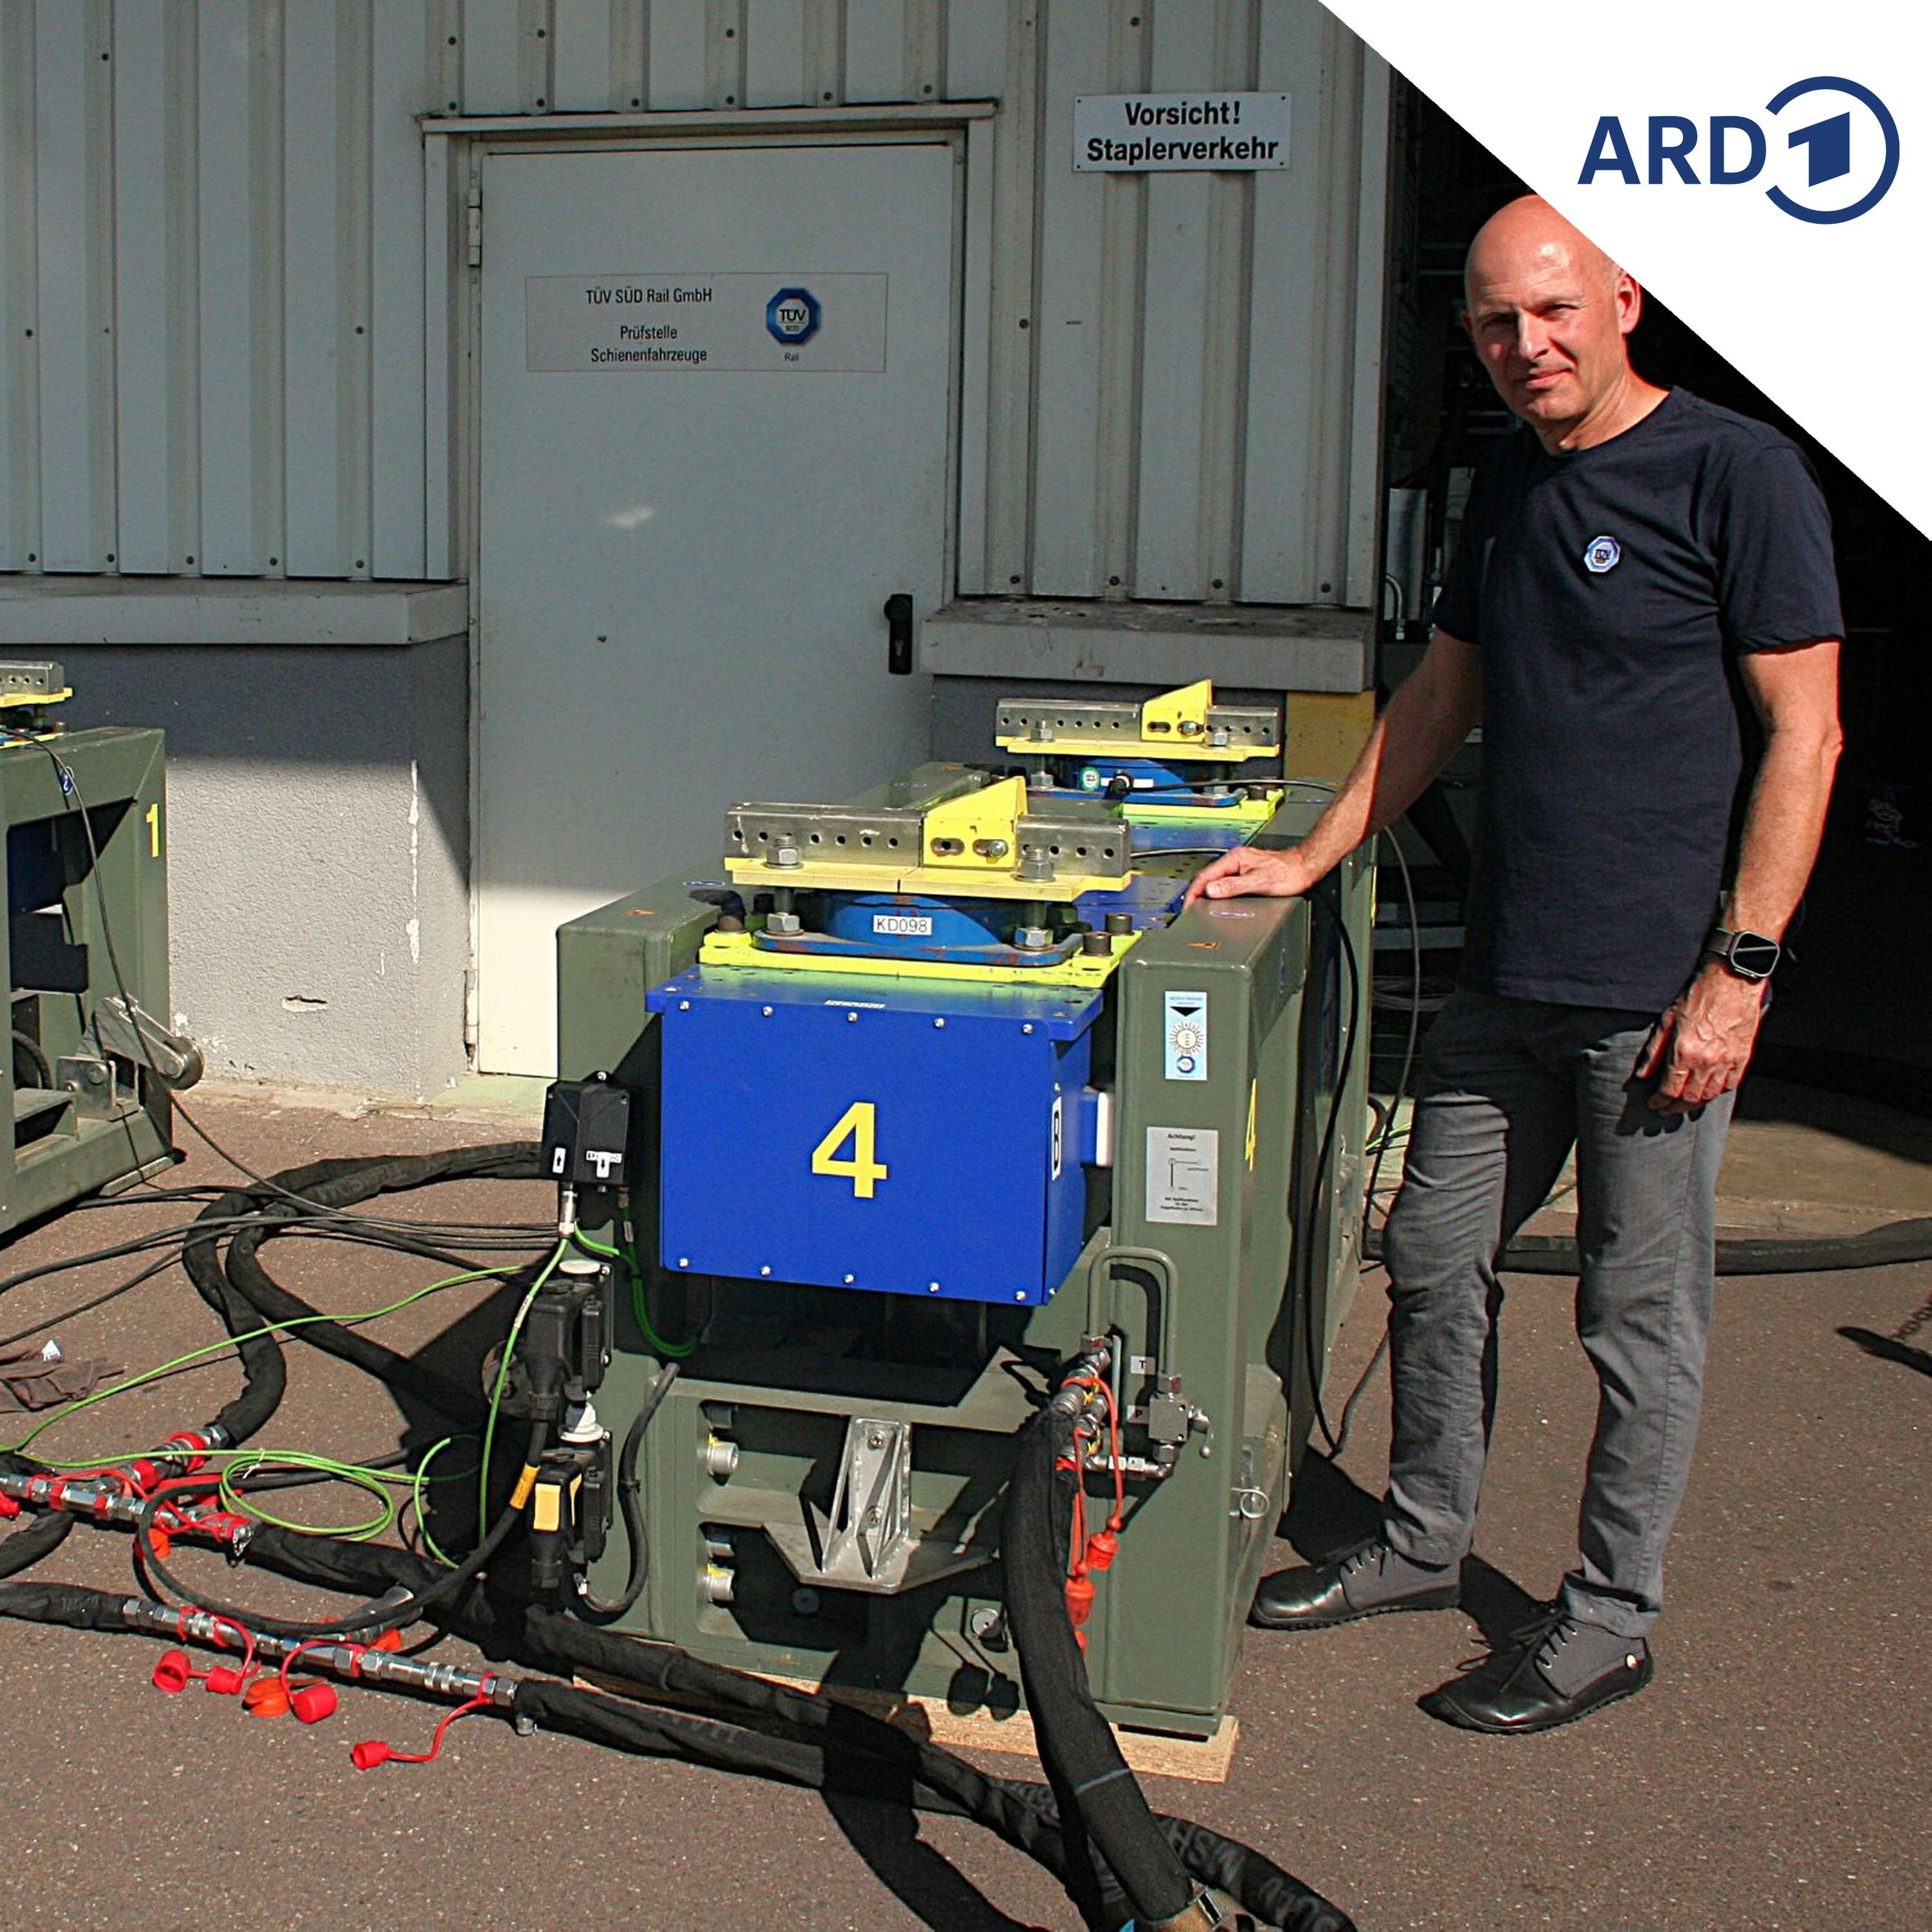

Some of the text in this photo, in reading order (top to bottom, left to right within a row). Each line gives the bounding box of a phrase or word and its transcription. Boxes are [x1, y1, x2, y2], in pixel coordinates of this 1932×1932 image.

[1125, 101, 1240, 126] Vorsicht!
[1087, 136, 1278, 166] Staplerverkehr
[586, 286, 712, 304] TÜV SÜD Rail GmbH
[620, 325, 677, 339] Prüfstelle
[591, 348, 707, 365] Schienenfahrzeuge
[146, 804, 159, 858] 1
[876, 918, 927, 933] KD098
[812, 1102, 887, 1198] 4
[1139, 1360, 1147, 1369] T
[1135, 1410, 1142, 1418] P
